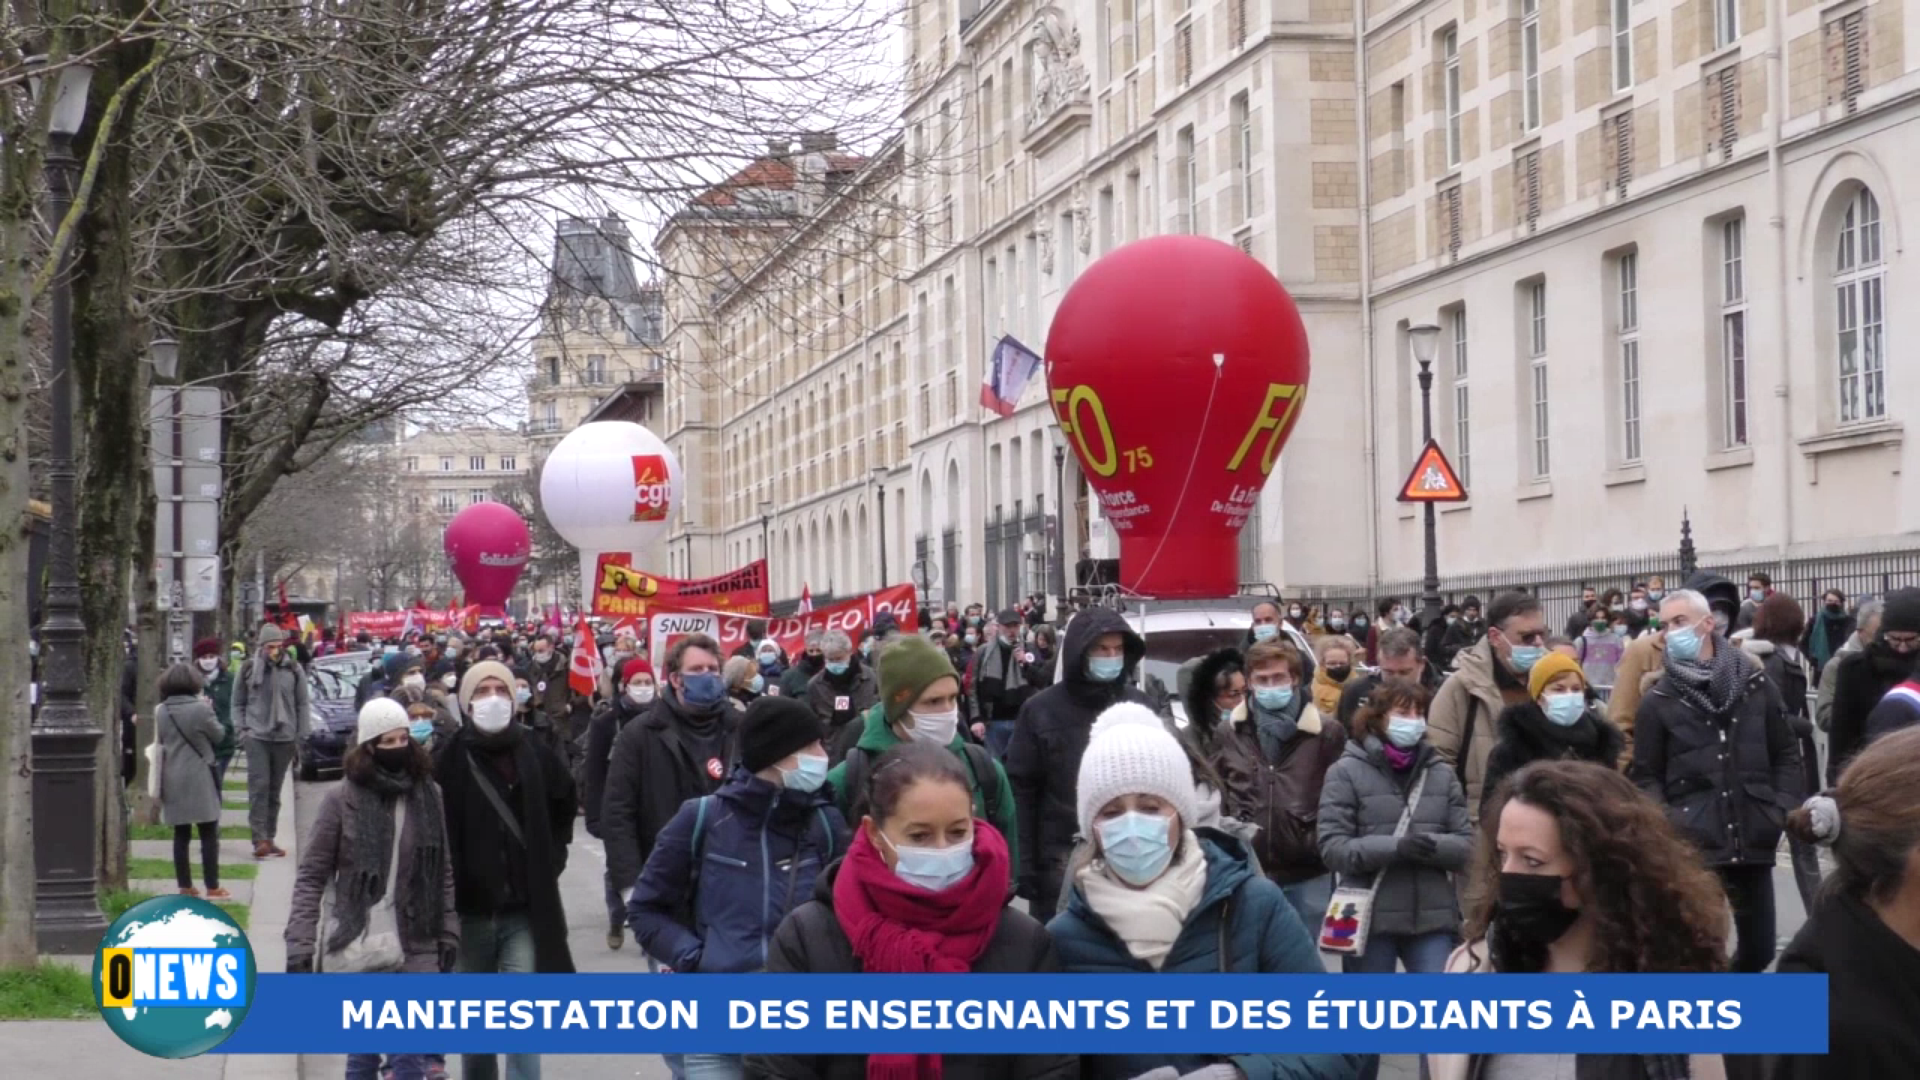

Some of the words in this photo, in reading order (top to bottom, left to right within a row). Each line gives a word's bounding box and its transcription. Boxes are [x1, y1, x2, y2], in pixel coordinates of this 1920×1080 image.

[1051, 384, 1118, 477] FO
[1225, 382, 1307, 476] FO
[1123, 446, 1153, 474] 75
[600, 563, 658, 597] FO
[598, 594, 646, 616] PARI
[658, 617, 712, 634] SNUDI
